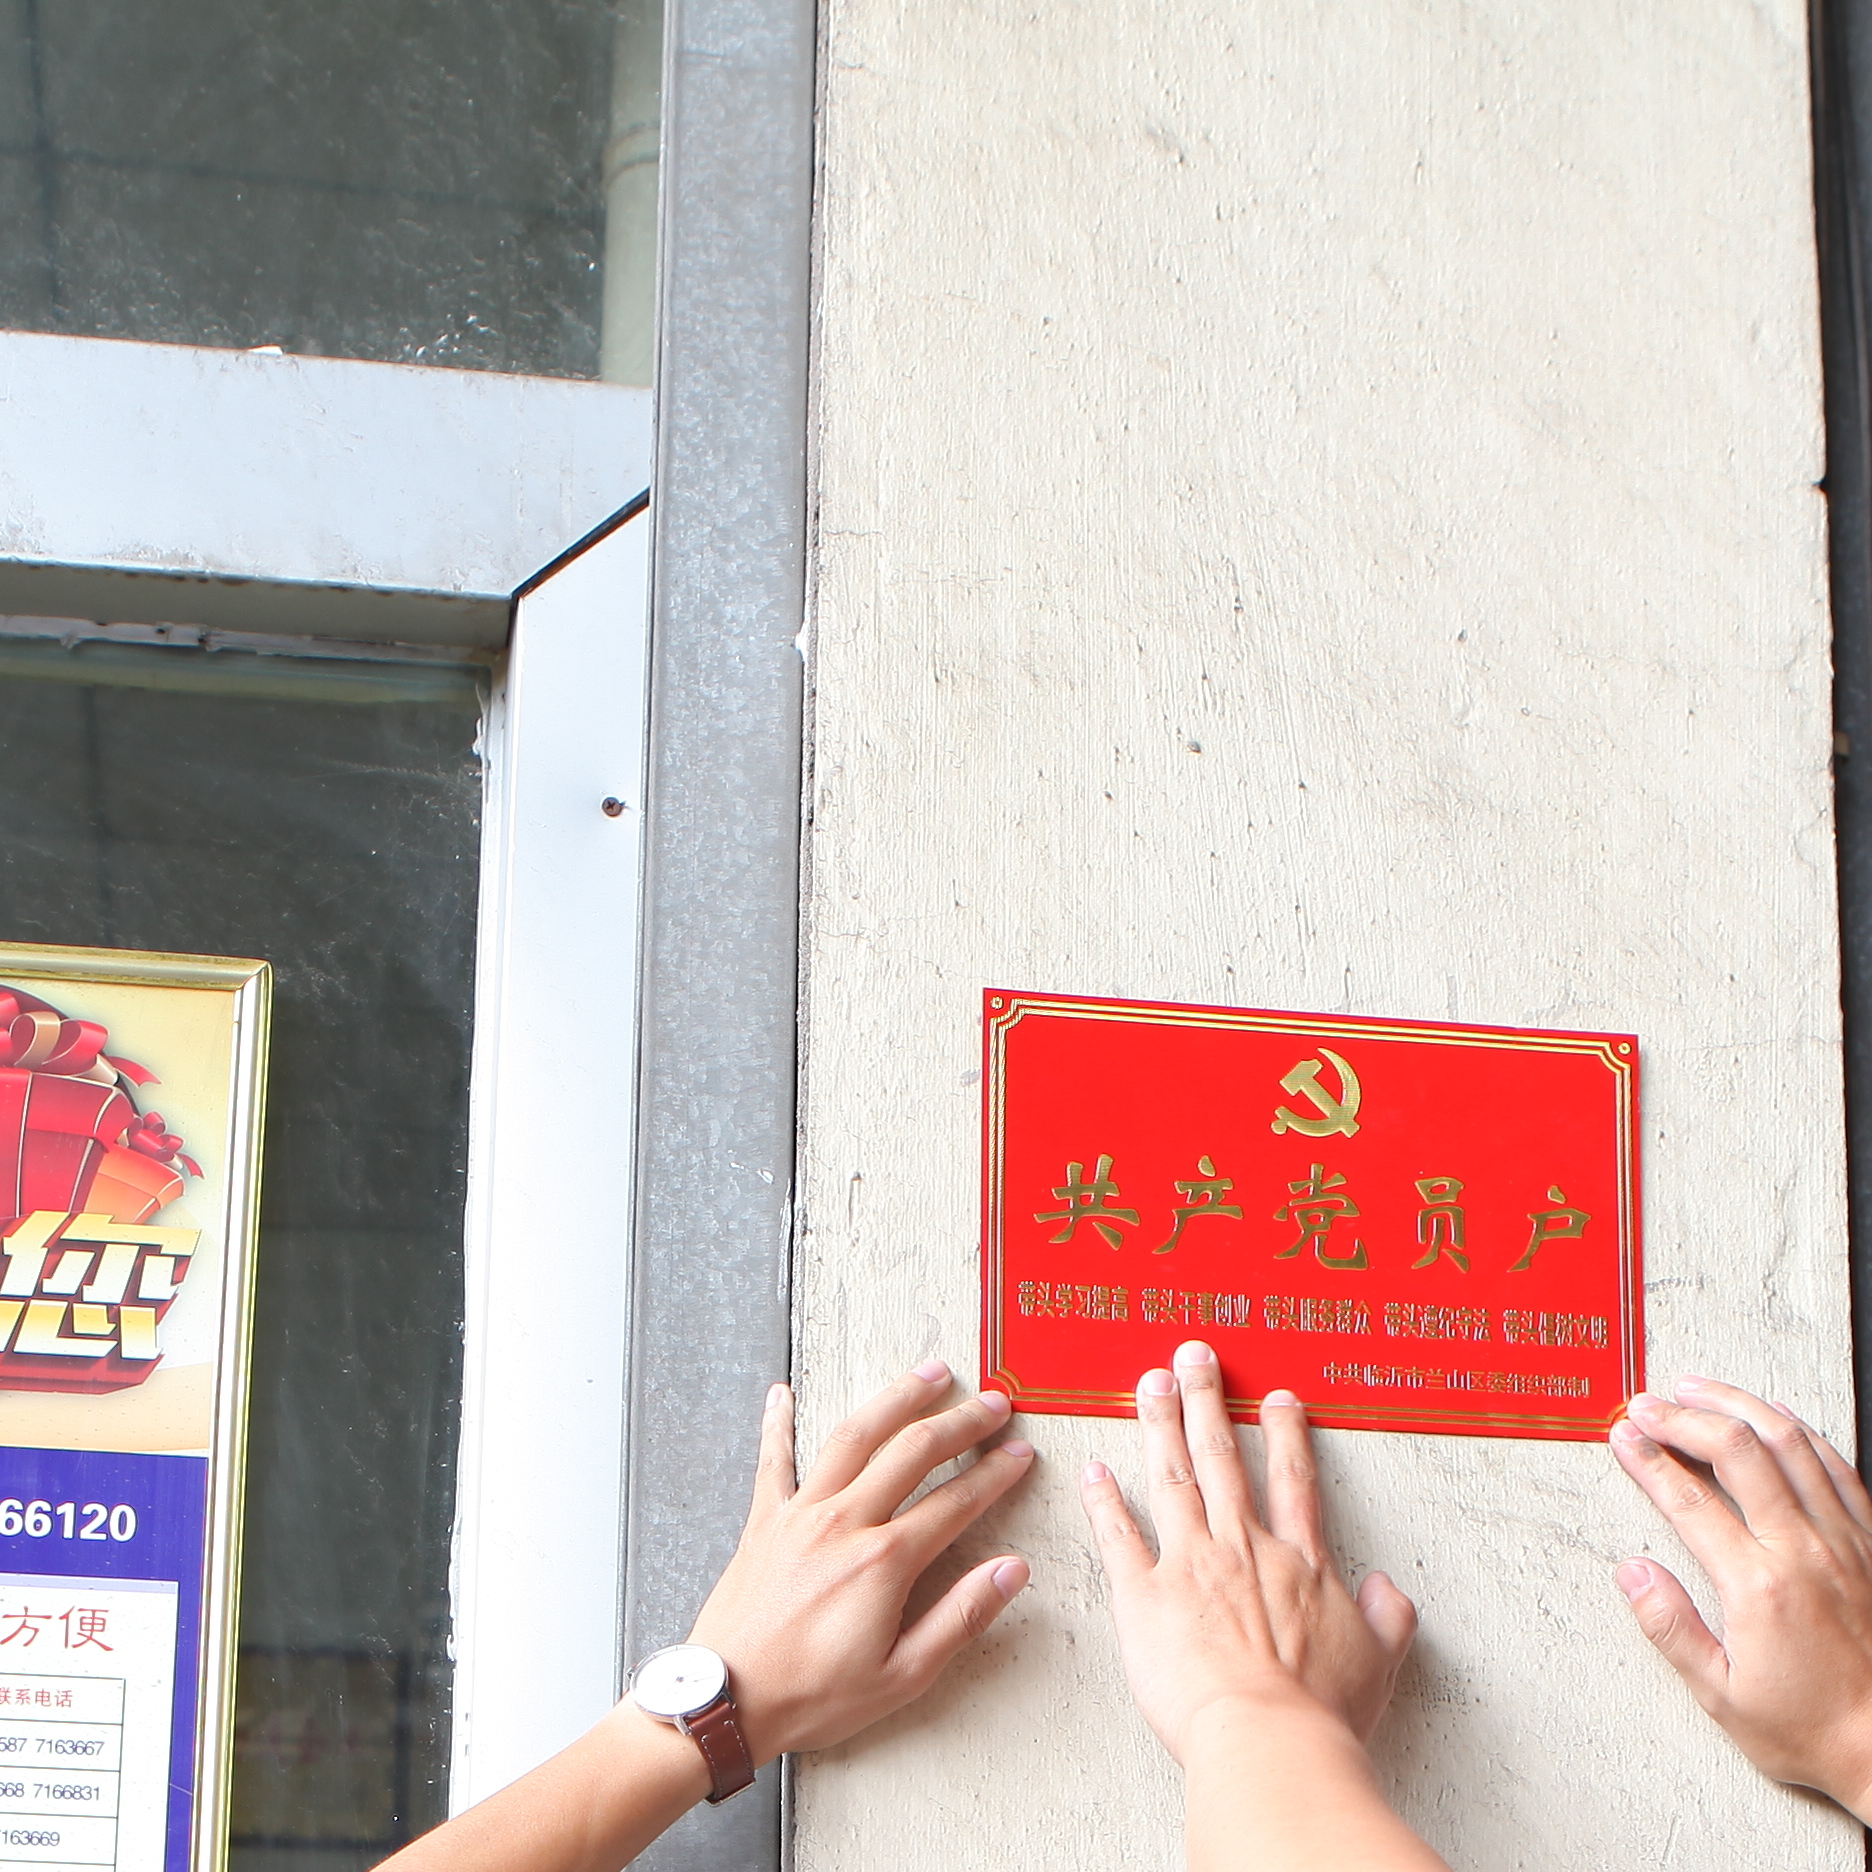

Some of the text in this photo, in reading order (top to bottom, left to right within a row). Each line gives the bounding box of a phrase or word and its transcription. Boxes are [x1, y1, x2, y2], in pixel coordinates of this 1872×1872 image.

[1032, 1153, 1593, 1273] 共产党员户
[1017, 1280, 1131, 1322] 带头学习提高
[1140, 1287, 1252, 1329] 带头干事创业
[1262, 1293, 1374, 1336] 带头服务群众
[1383, 1301, 1493, 1343] 带头遵纪守法
[34, 1737, 106, 1757] 7163667
[32, 1783, 102, 1802] 7166831
